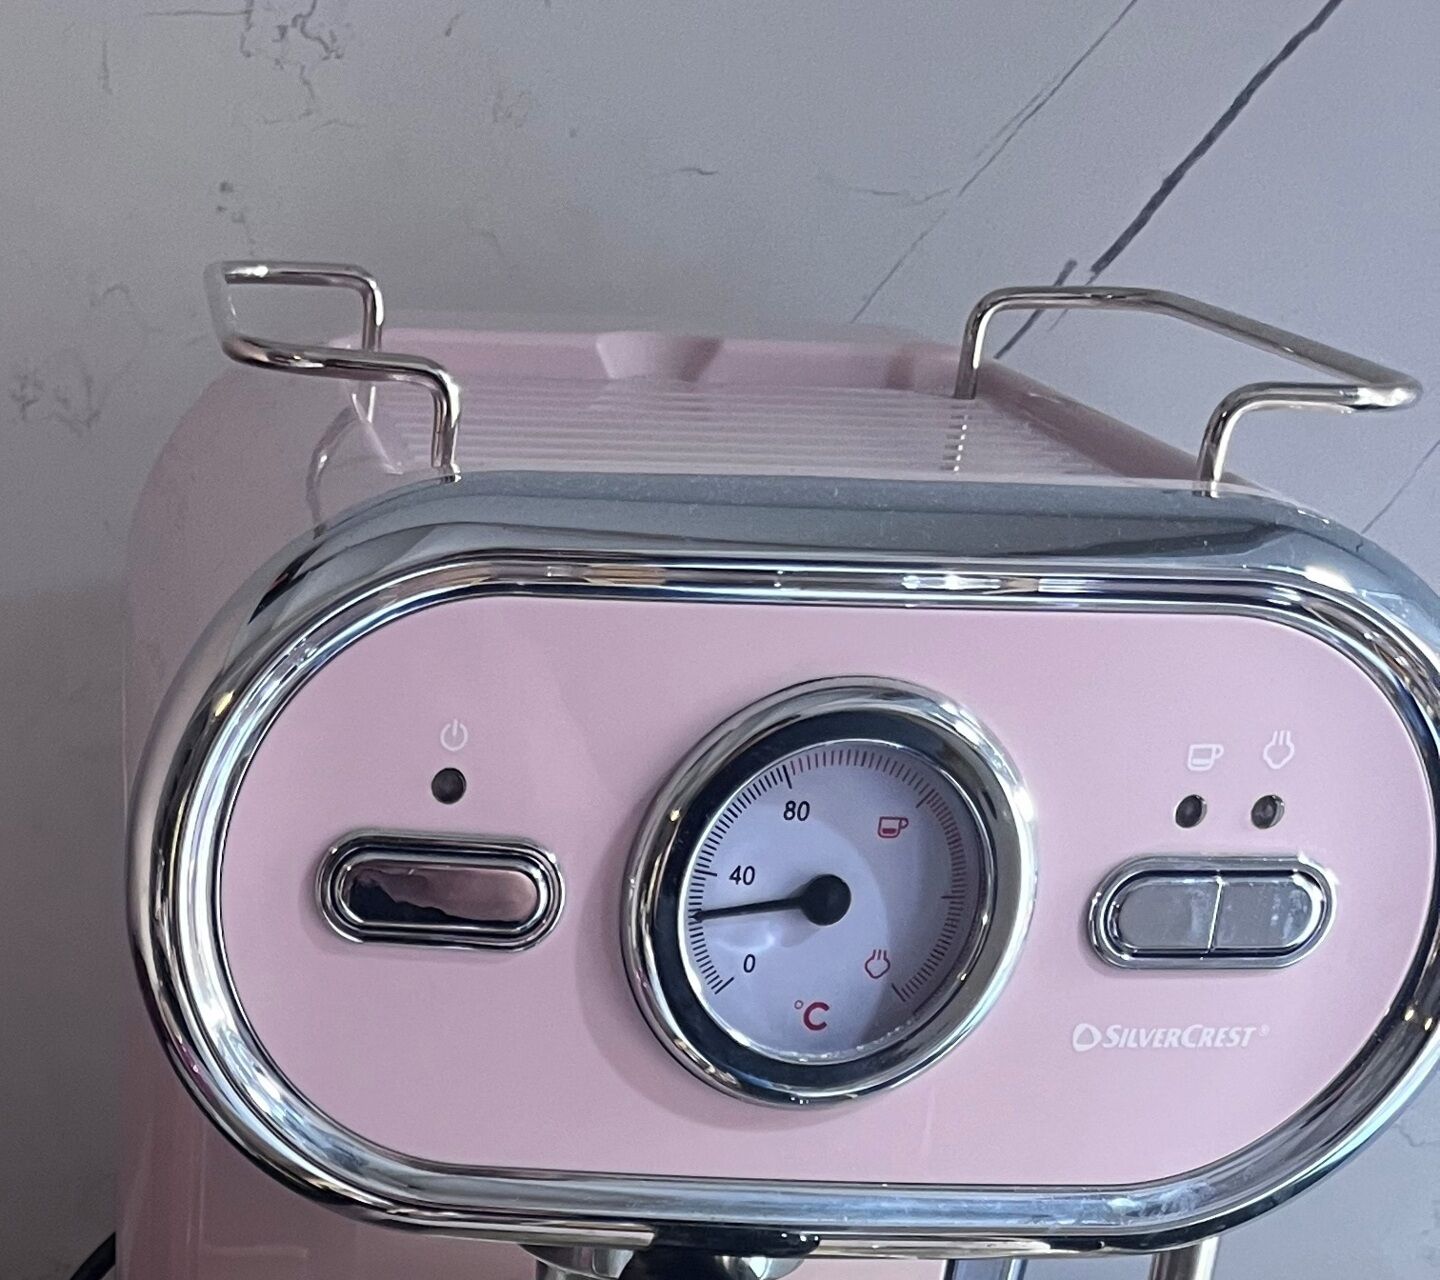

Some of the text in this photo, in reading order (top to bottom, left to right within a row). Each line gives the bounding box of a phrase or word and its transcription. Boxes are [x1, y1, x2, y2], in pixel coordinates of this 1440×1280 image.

[783, 800, 811, 822] 80
[729, 865, 756, 885] 40
[743, 953, 756, 973] 0
[794, 999, 830, 1031] °C
